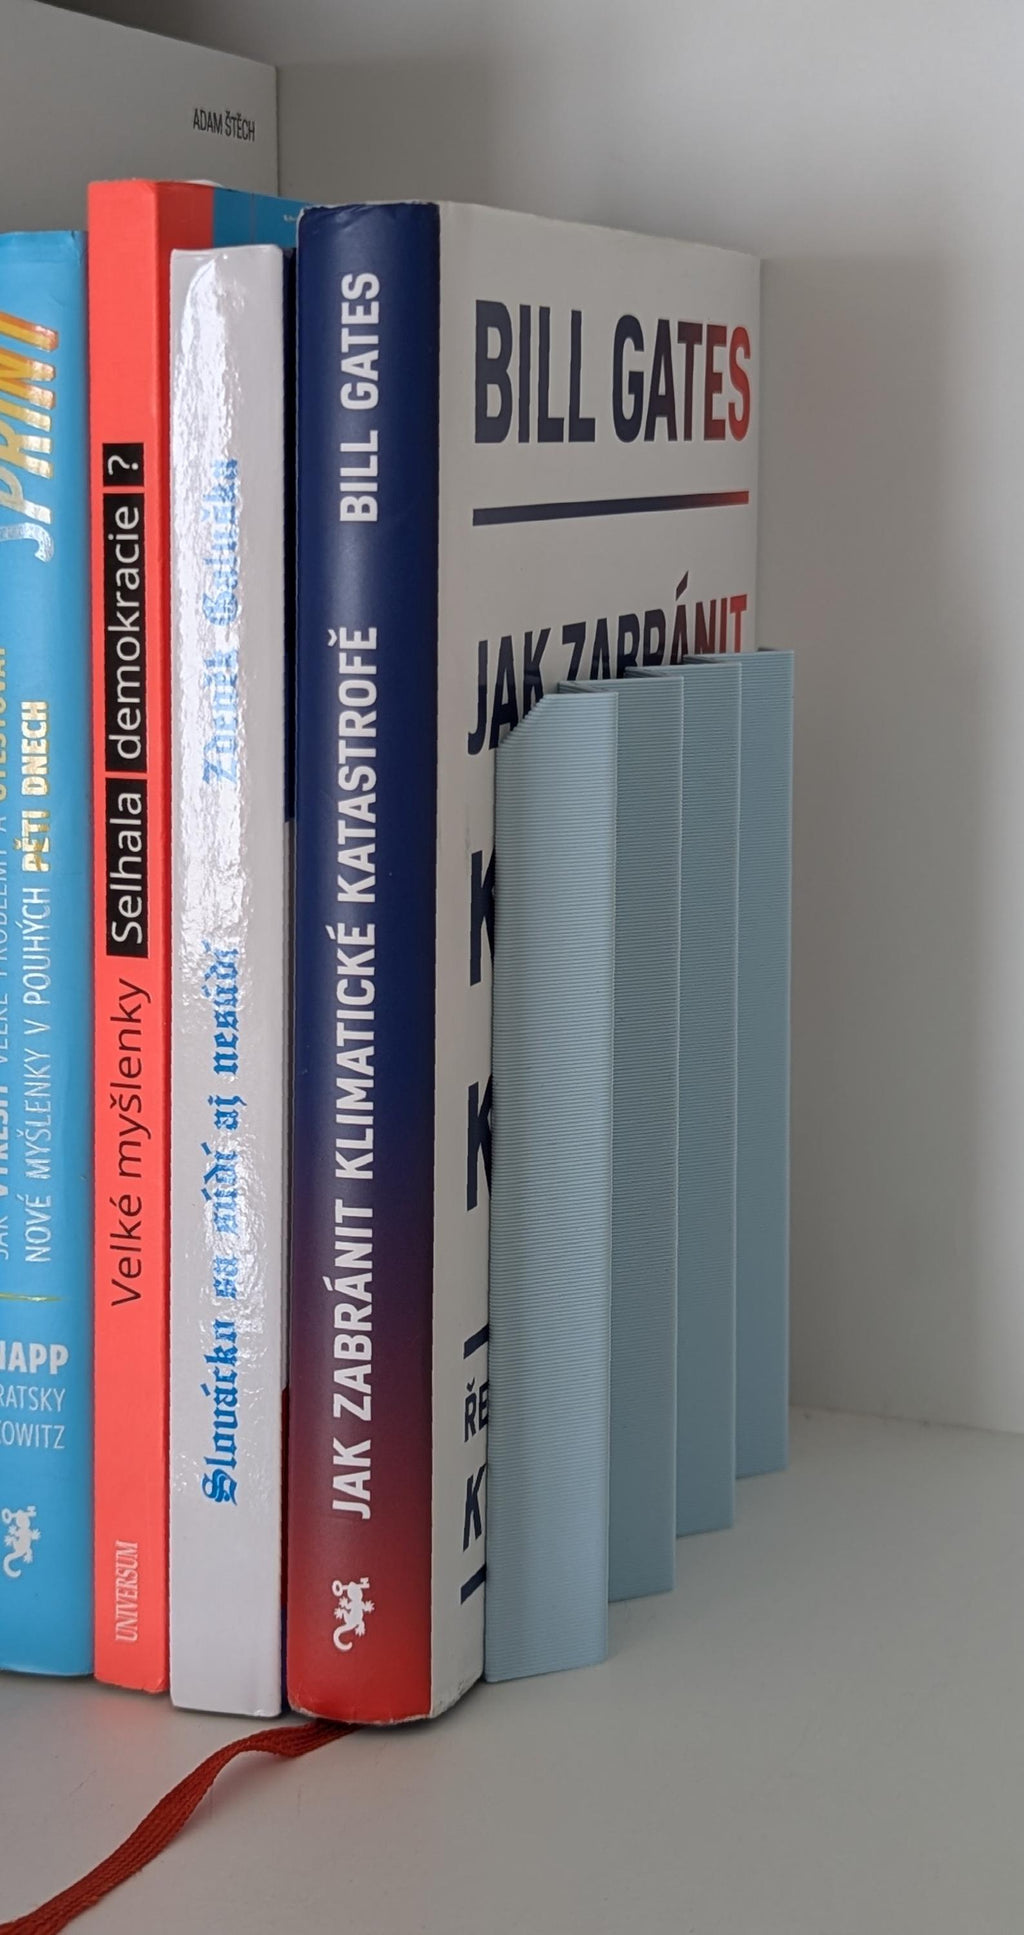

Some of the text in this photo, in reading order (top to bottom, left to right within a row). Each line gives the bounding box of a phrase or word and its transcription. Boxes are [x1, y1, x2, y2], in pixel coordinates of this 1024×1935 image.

[193, 108, 256, 142] ADAM ŠTĚCH
[340, 273, 380, 521] BILL GATES
[474, 299, 752, 444] BILL GATES
[467, 627, 551, 756] JAK
[107, 454, 151, 1307] Velké myšlenky Selhala demokracie ?
[13, 701, 52, 1263] NOVÉ MYŠLENKY V POUHÝCH PĚTI DNECH
[208, 1094, 247, 1130] aj
[322, 626, 378, 1520] JAK ZABRÁNIT KLIMATICKÉ KATASTROFĚ
[0, 1420, 65, 1449] OWITZ
[115, 1540, 139, 1644] UNIVERSUM
